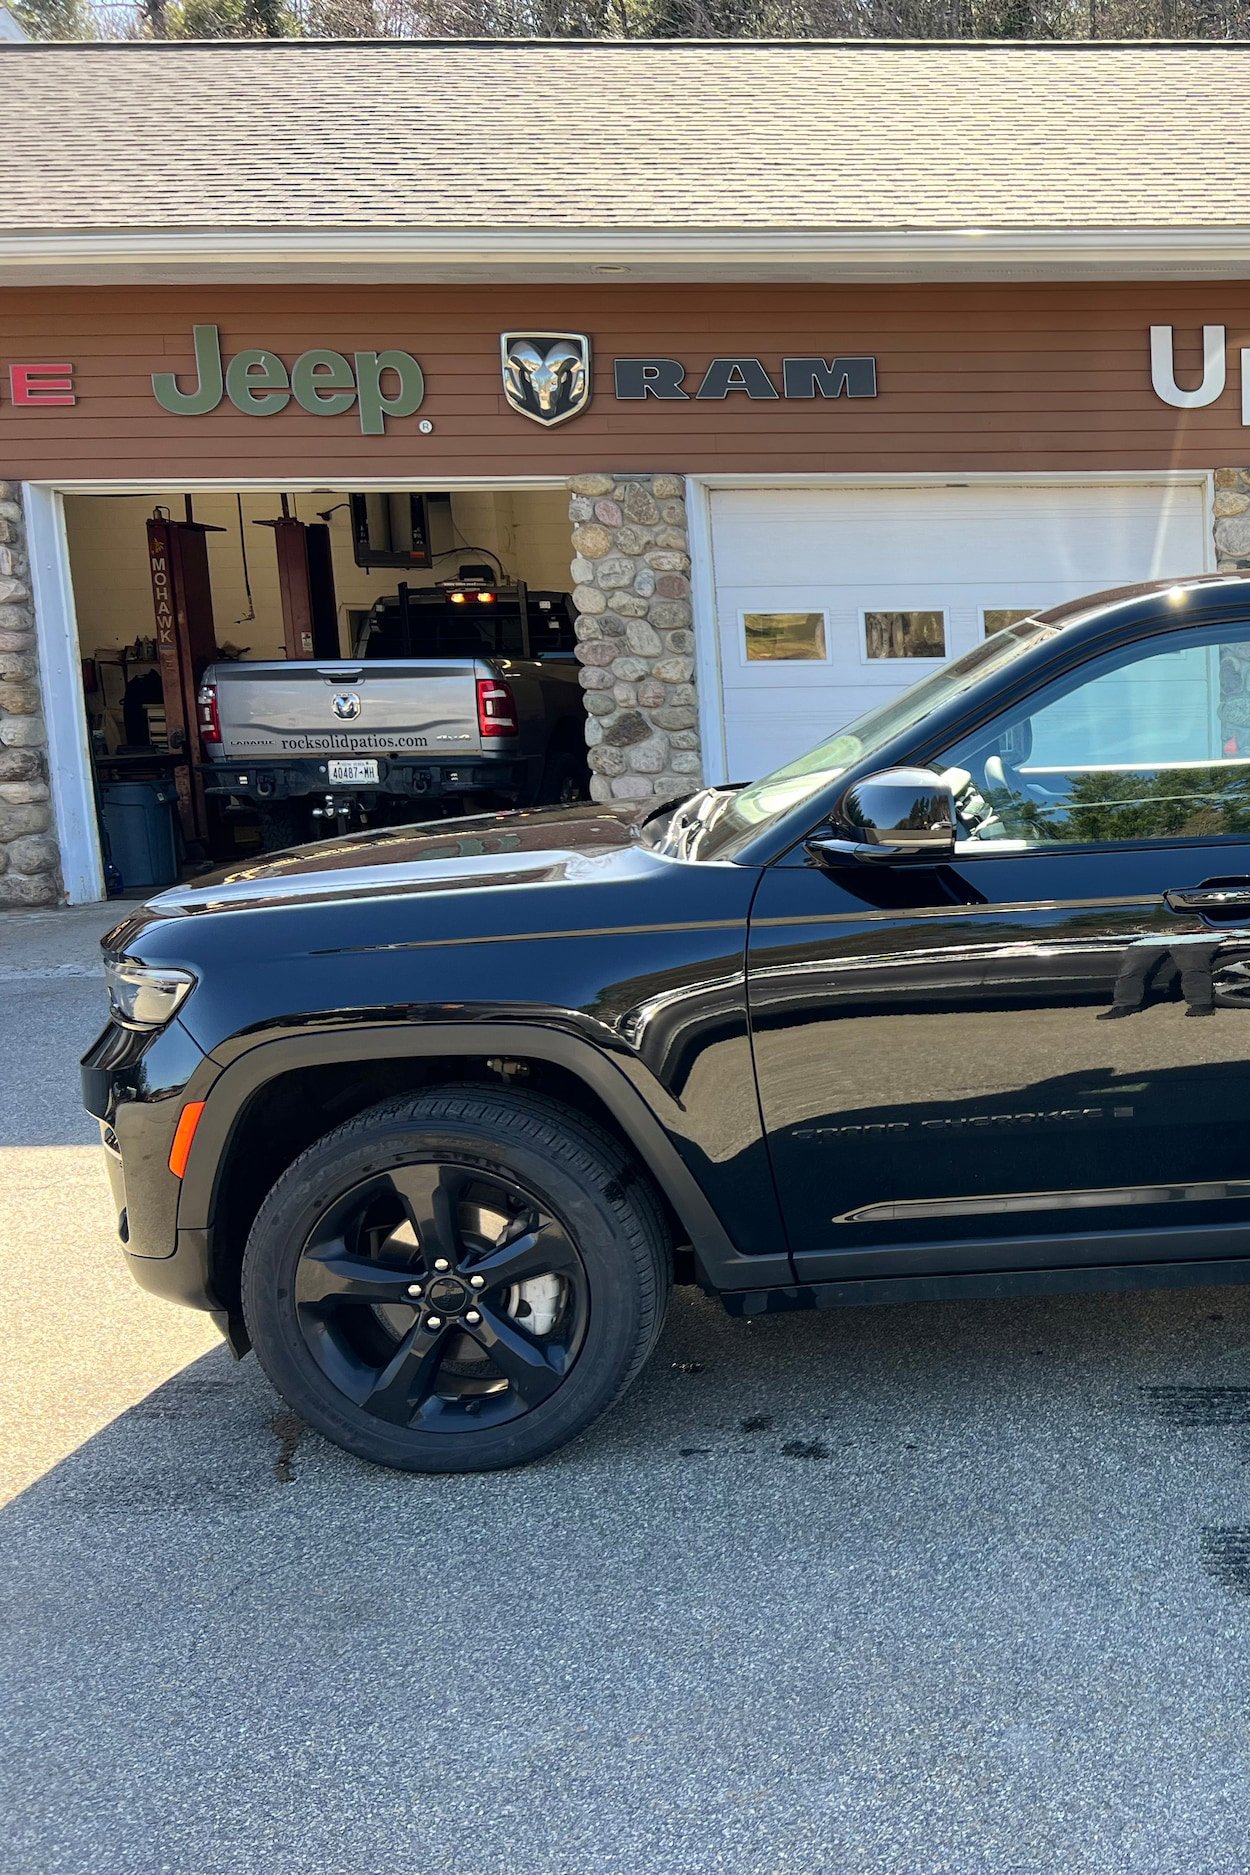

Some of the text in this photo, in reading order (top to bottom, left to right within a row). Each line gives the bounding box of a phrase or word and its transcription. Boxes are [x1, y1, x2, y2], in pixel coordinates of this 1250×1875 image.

[151, 324, 425, 435] Jeep
[613, 356, 878, 401] RAM
[151, 557, 173, 643] MOHAWK
[281, 735, 428, 750] rocksolidpatios.com
